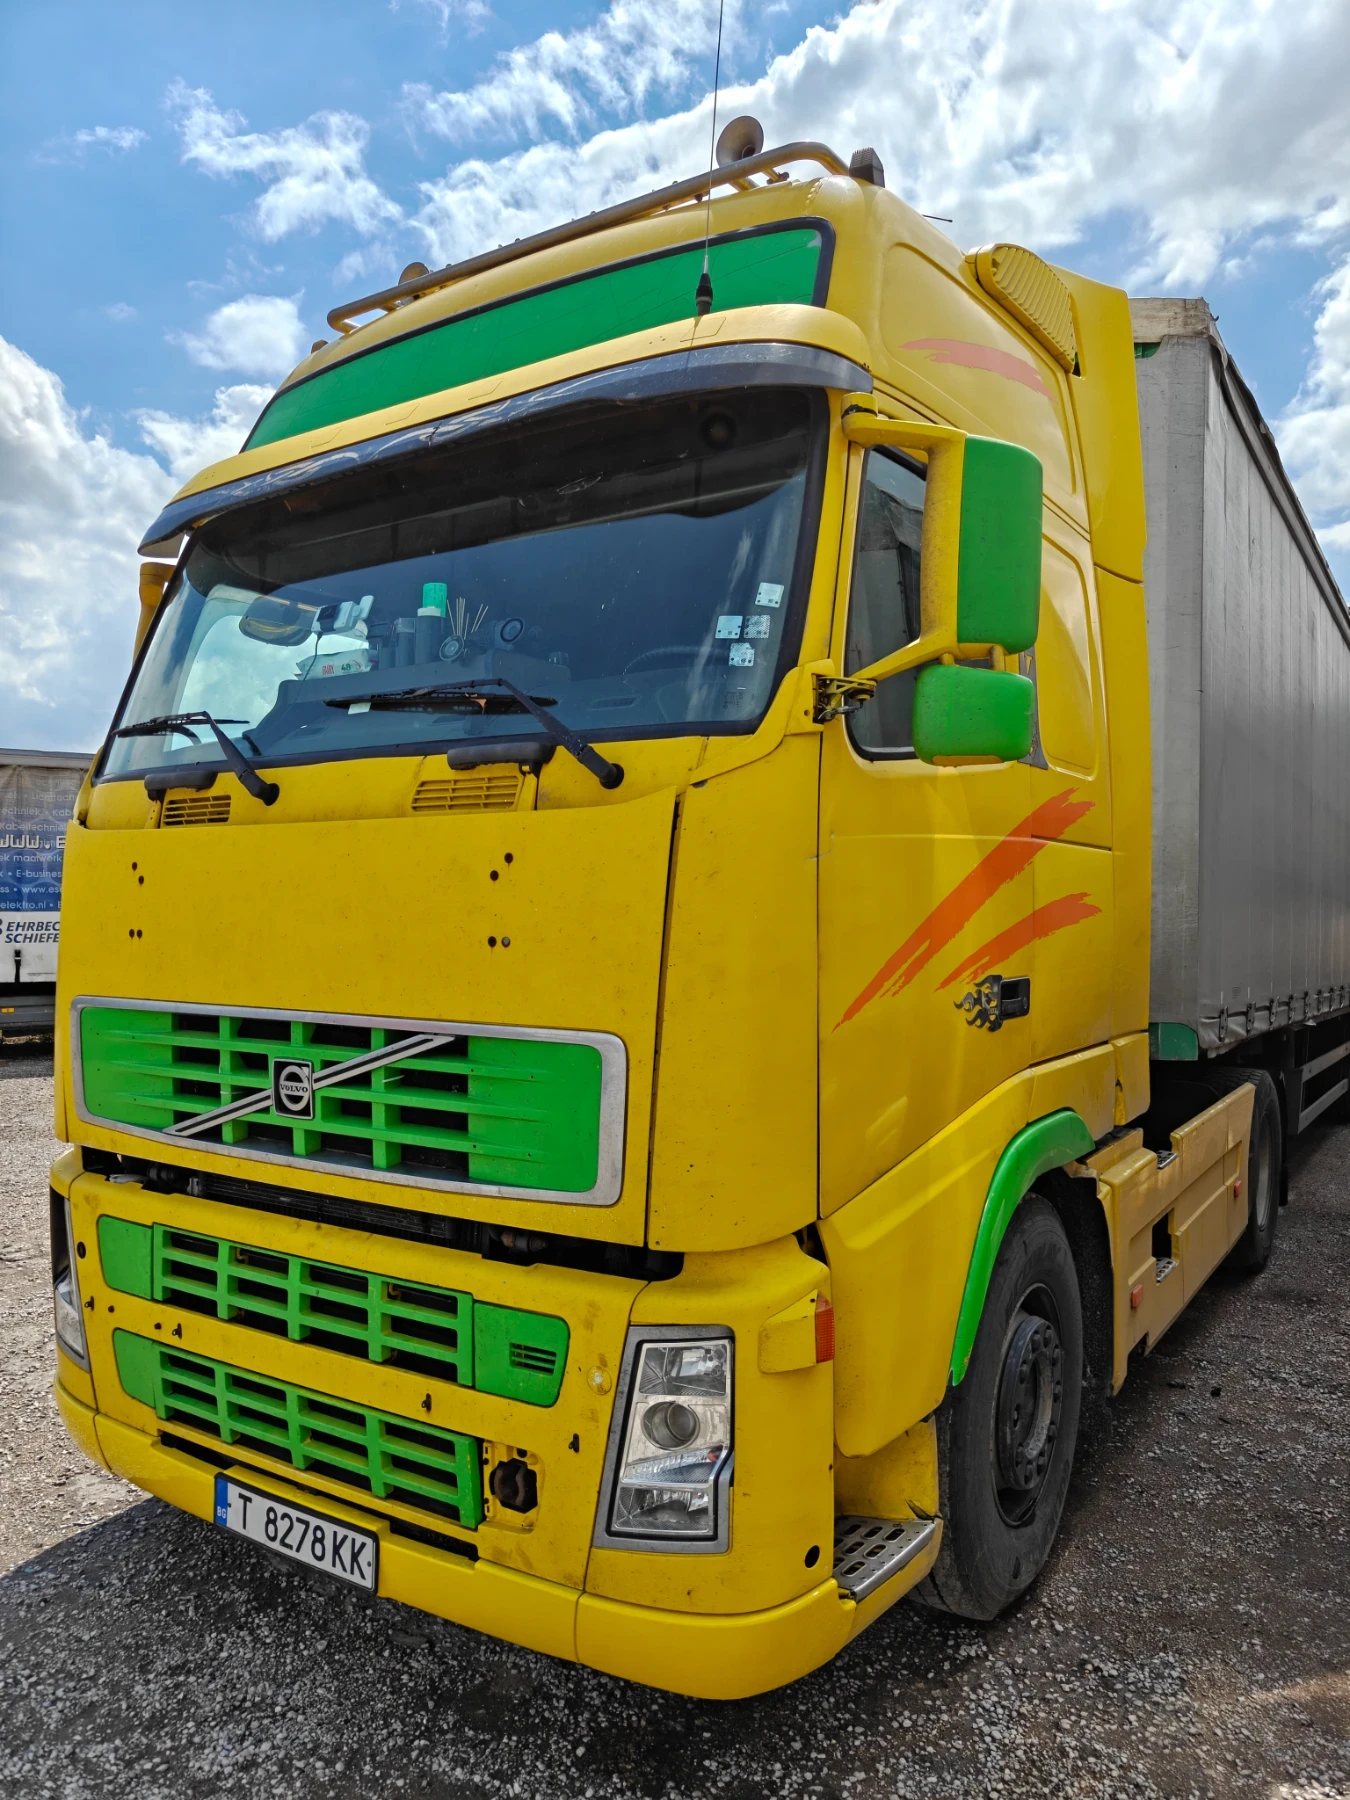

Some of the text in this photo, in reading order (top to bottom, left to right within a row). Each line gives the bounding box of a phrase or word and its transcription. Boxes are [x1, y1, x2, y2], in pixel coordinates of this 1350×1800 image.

[280, 1083, 309, 1093] VOLVO
[216, 1505, 227, 1519] BG
[238, 1492, 367, 1581] T 8278 KK
